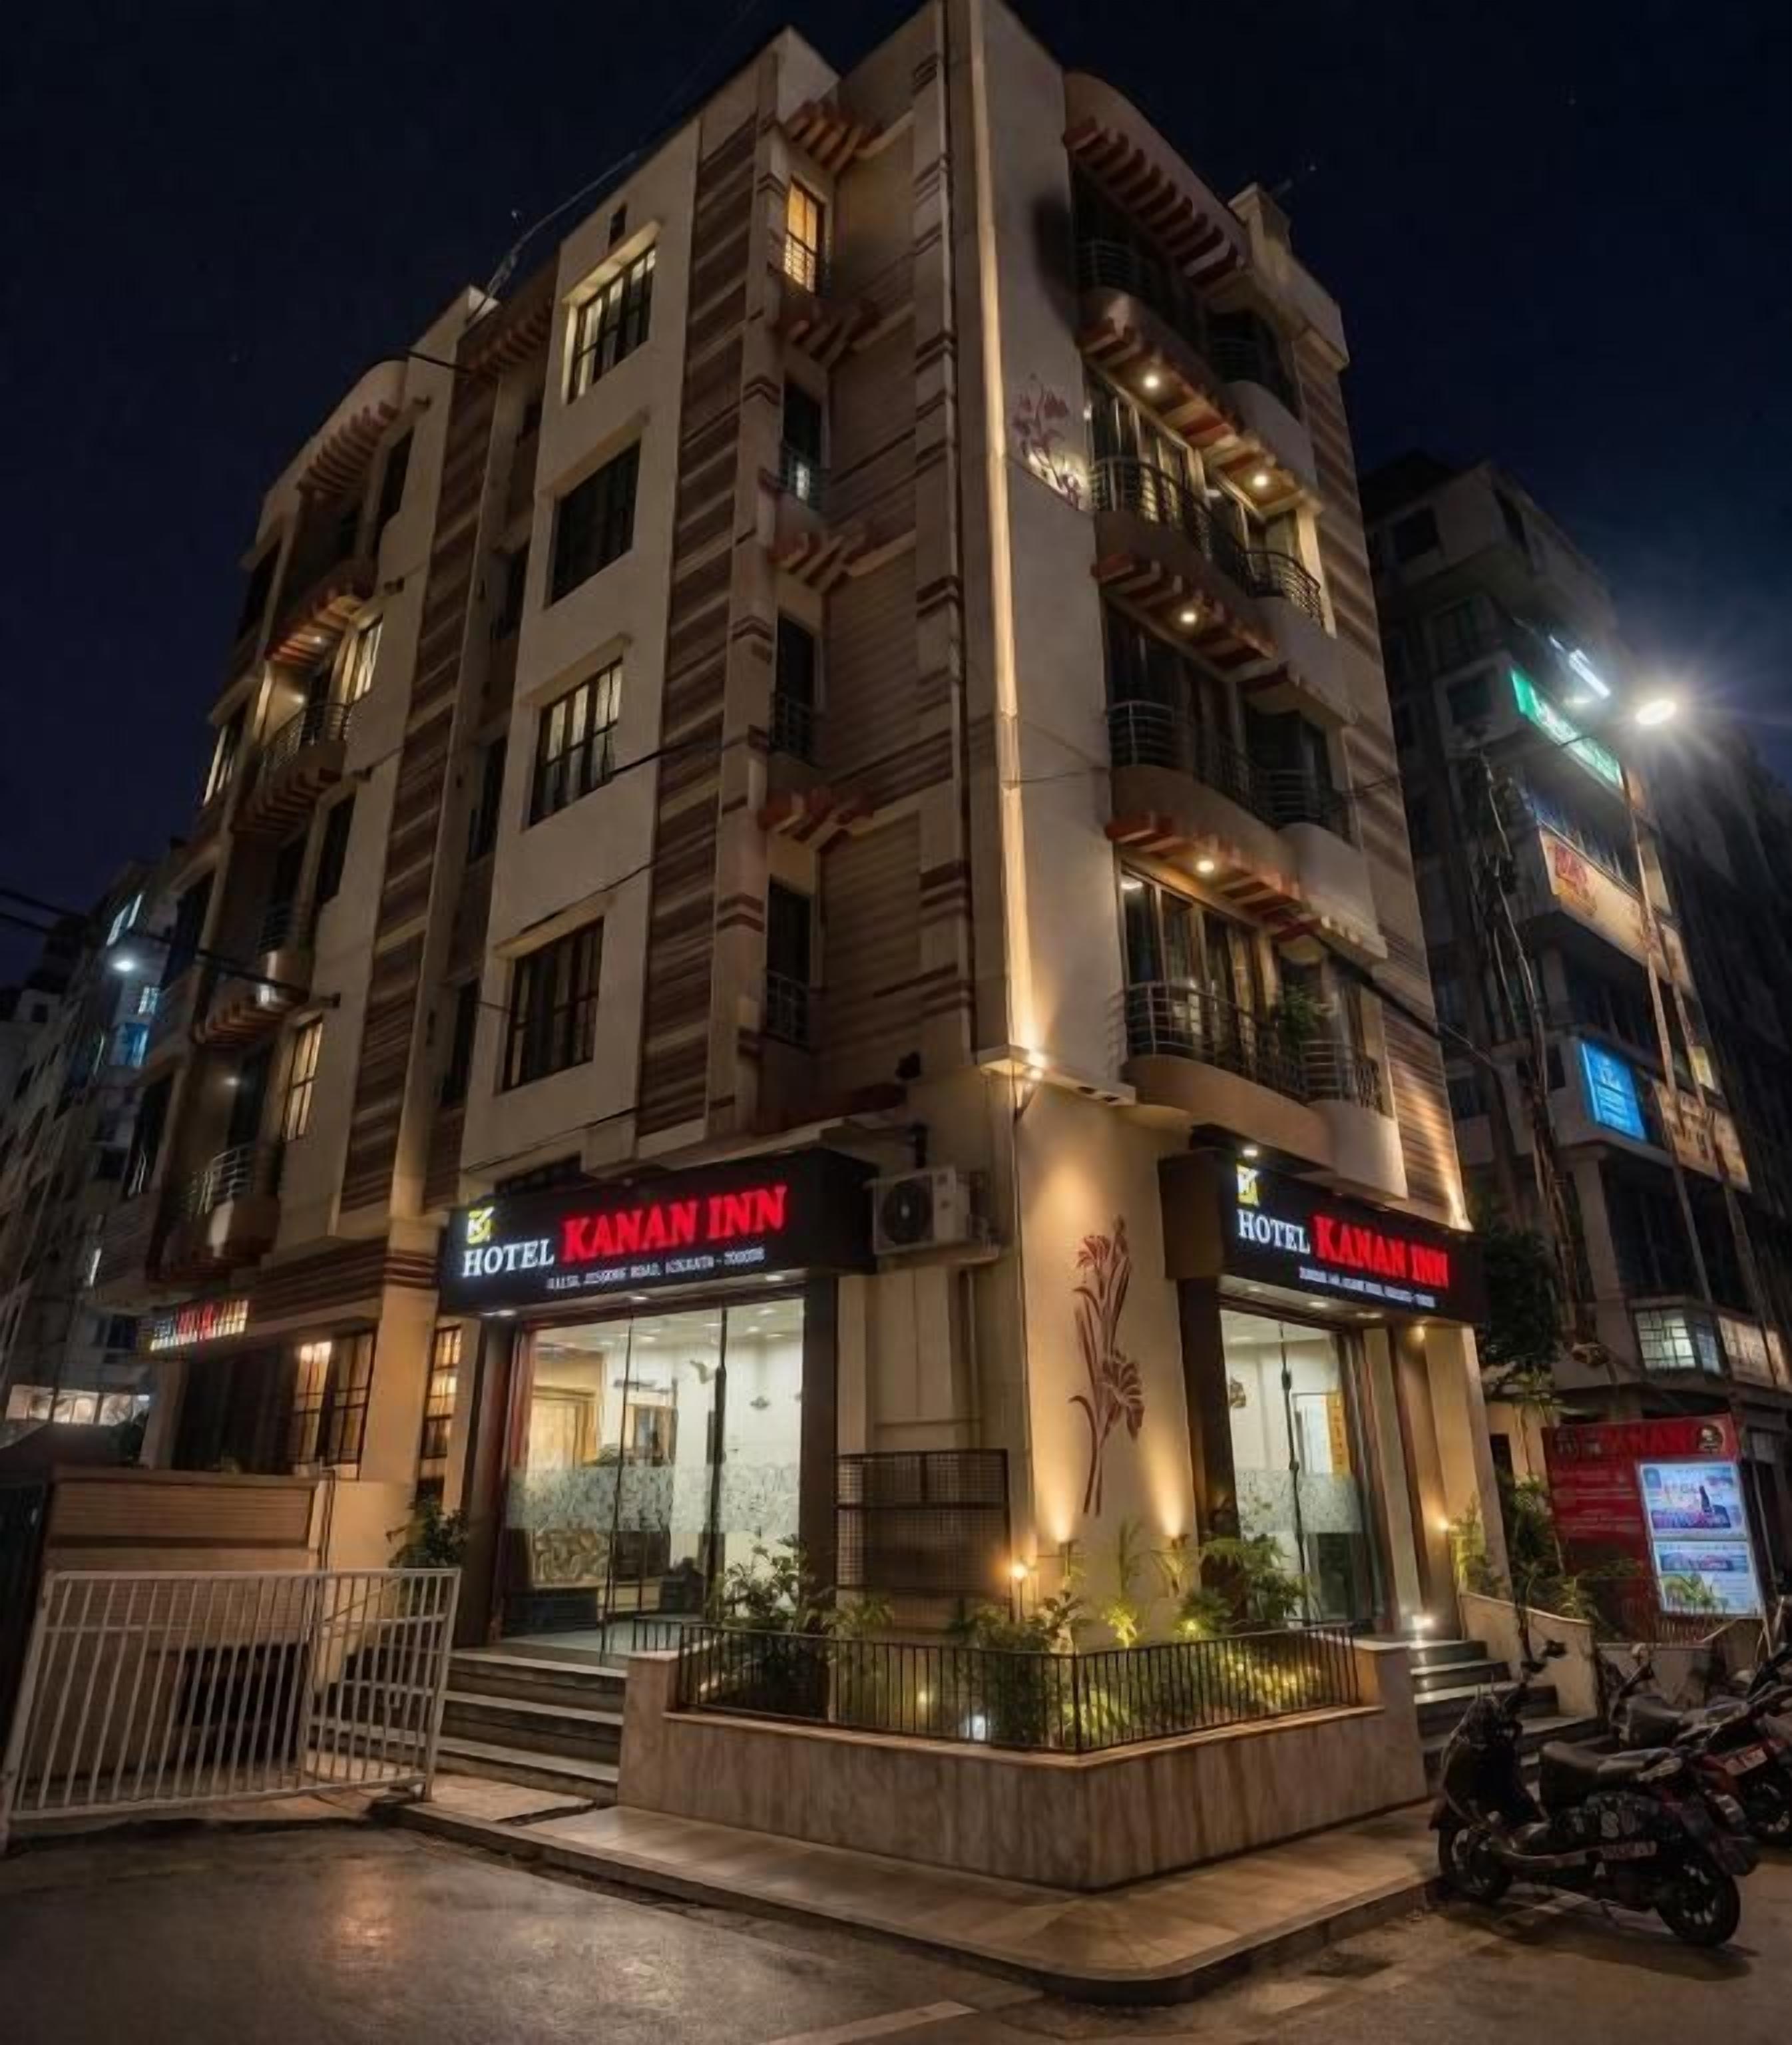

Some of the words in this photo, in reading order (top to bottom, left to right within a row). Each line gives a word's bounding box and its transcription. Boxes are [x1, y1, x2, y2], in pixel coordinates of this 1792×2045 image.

[463, 1239, 555, 1277] HOTEL
[562, 1201, 698, 1262] KANAN
[708, 1186, 788, 1240] INN
[1237, 1208, 1311, 1254] HOTEL
[1313, 1214, 1407, 1277] KANAN
[1411, 1245, 1449, 1289] INN
